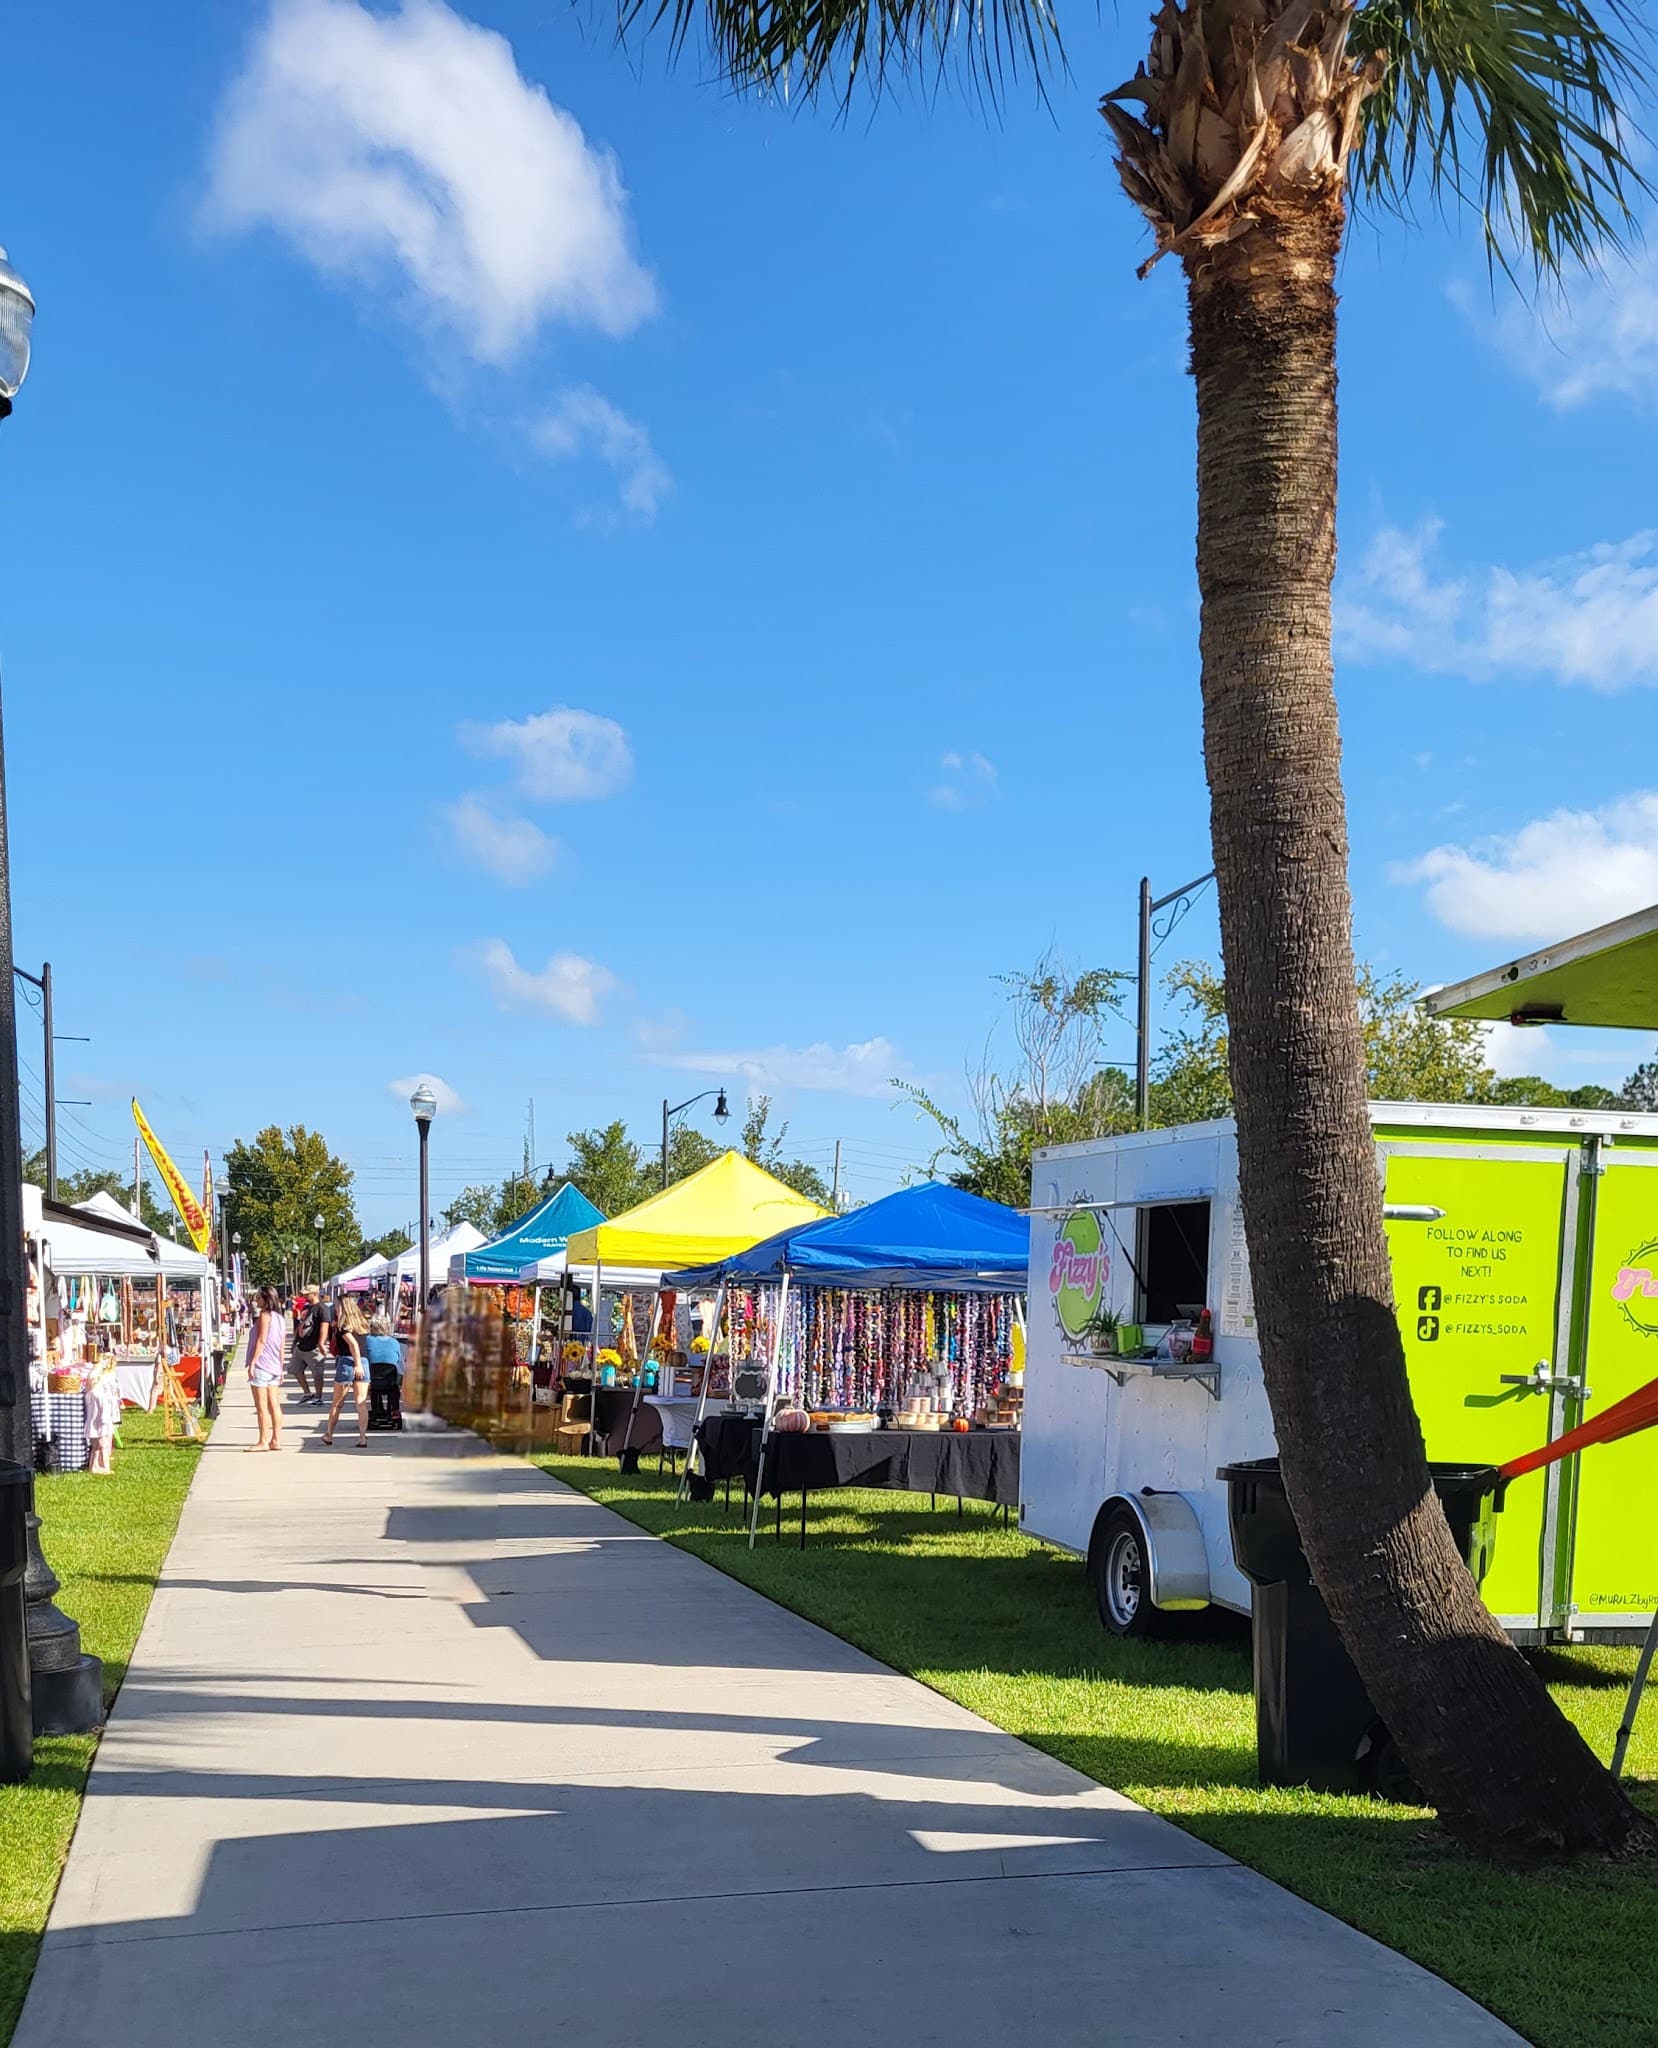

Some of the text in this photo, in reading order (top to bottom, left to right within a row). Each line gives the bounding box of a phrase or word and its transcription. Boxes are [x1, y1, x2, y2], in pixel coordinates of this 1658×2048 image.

[519, 1236, 558, 1244] Modern
[1427, 1227, 1523, 1243] FOLLOW ALONG
[1446, 1246, 1507, 1261] TO FIND US
[1049, 1238, 1111, 1300] Fizzy's
[1460, 1265, 1492, 1278] NEXT!
[1455, 1293, 1495, 1305] FIZZY'S
[1498, 1294, 1528, 1305] SODA
[1455, 1323, 1528, 1336] FIZZYS_SODA
